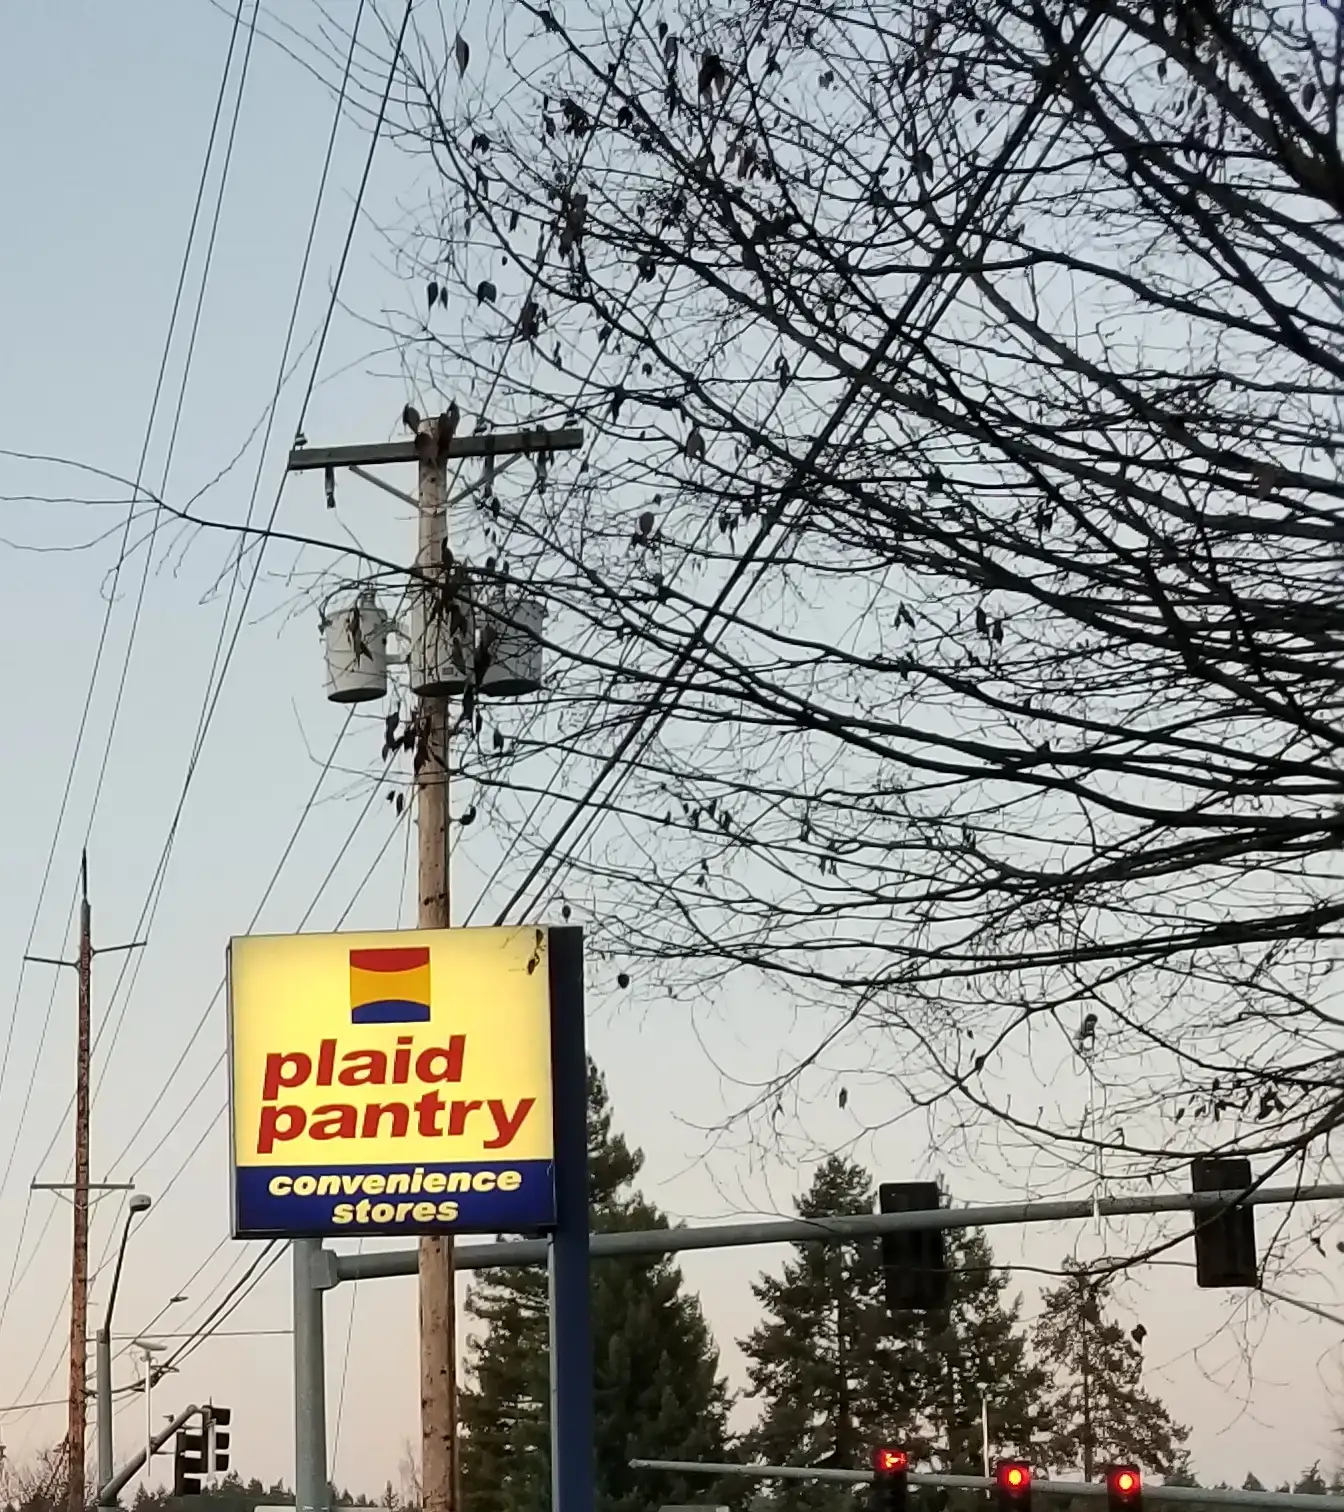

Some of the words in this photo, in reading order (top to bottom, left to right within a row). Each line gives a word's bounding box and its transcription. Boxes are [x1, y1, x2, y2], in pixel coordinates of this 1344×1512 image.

[263, 1034, 466, 1100] plaid
[257, 1089, 536, 1154] pantry
[269, 1167, 522, 1196] convenience
[332, 1199, 459, 1224] stores
